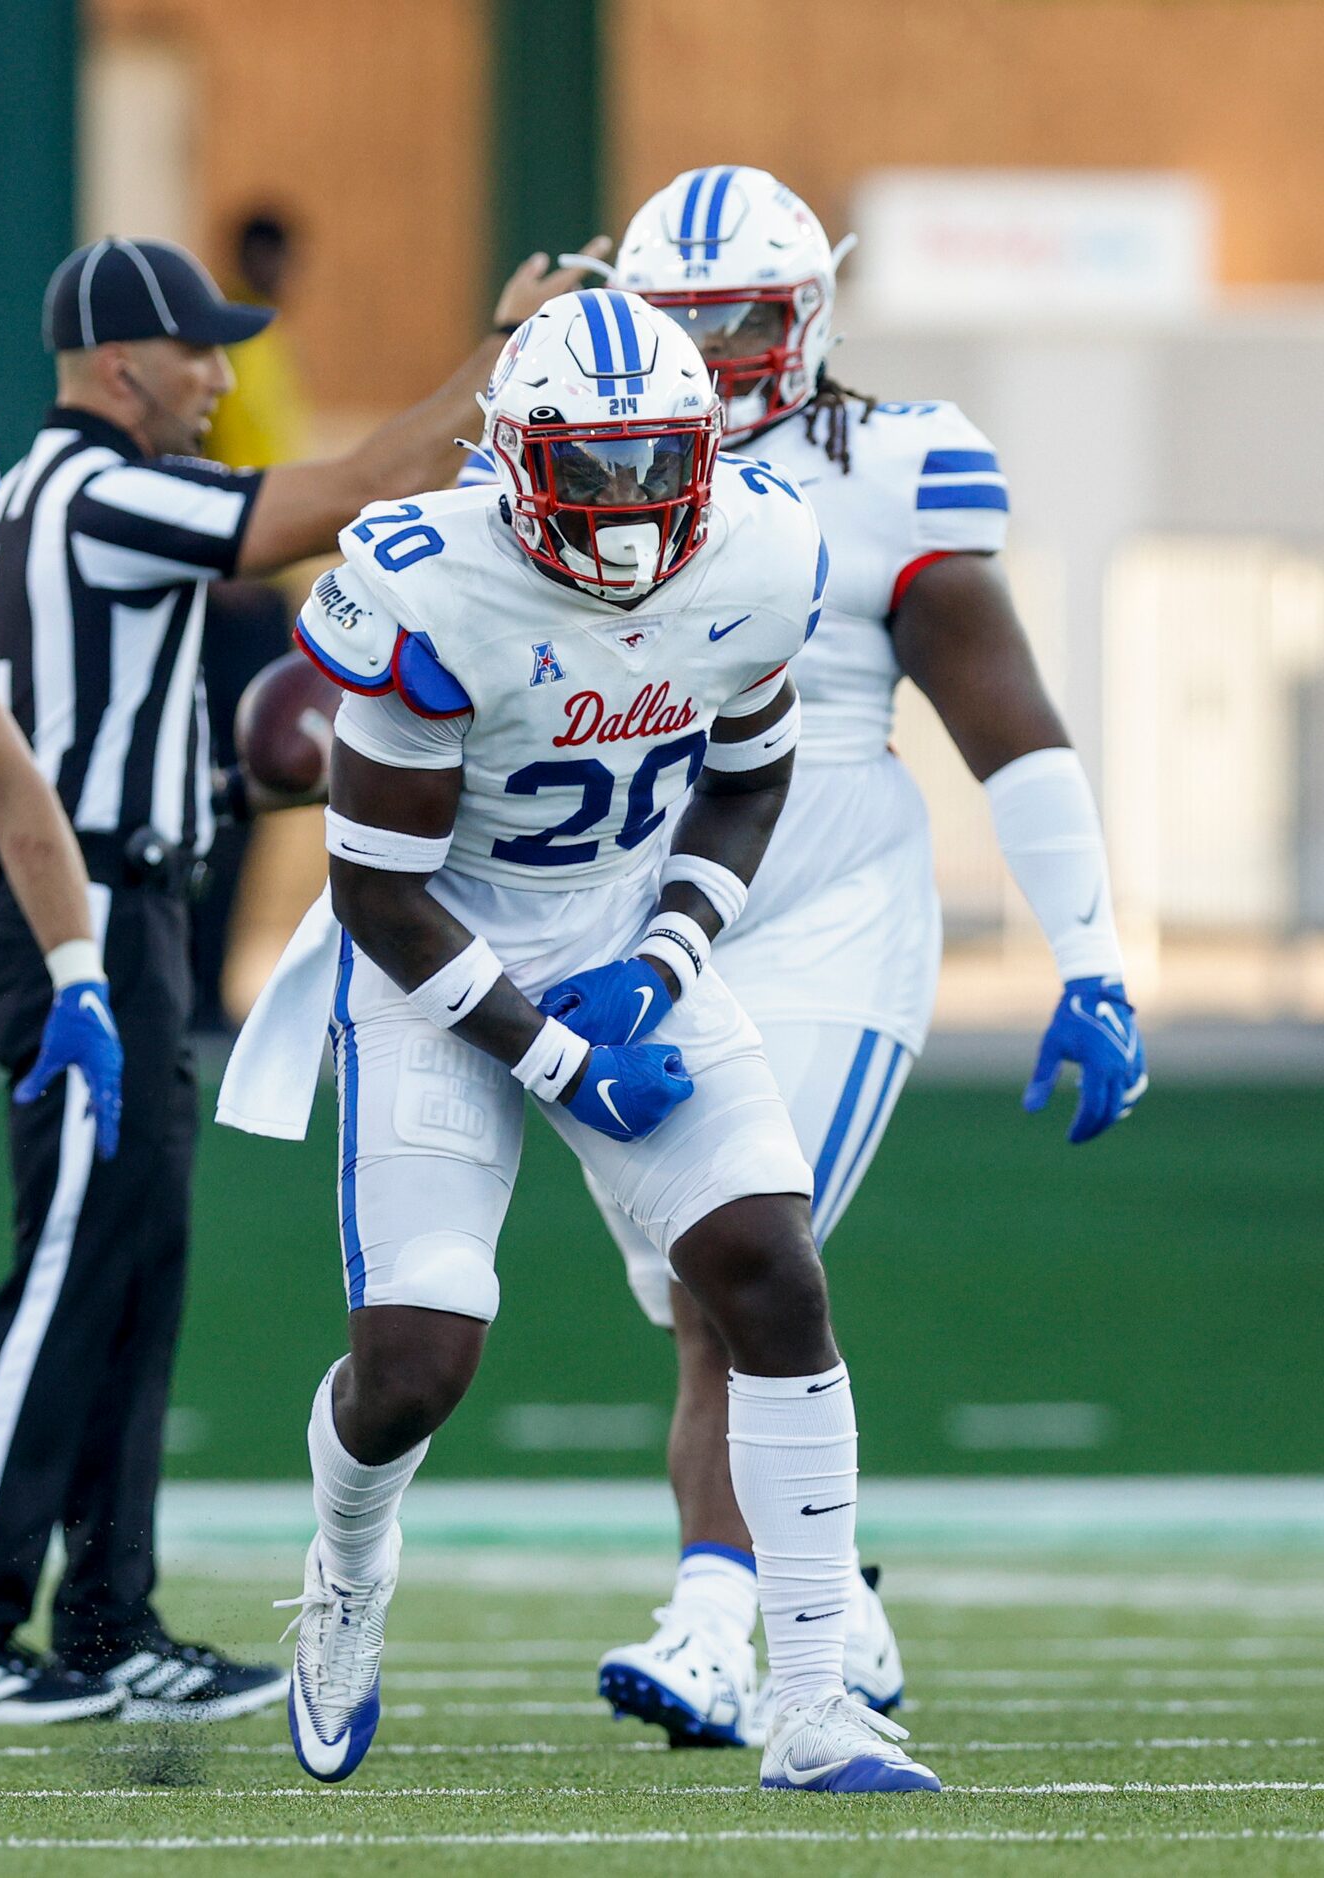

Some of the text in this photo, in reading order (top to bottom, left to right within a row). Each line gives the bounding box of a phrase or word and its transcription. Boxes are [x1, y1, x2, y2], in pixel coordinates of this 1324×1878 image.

[609, 397, 638, 415] 214
[351, 504, 445, 573] 20
[552, 680, 698, 748] Dallas
[491, 729, 708, 867] 20
[409, 1038, 505, 1090] CHILD
[449, 1077, 471, 1099] OF
[421, 1092, 485, 1139] GOD
